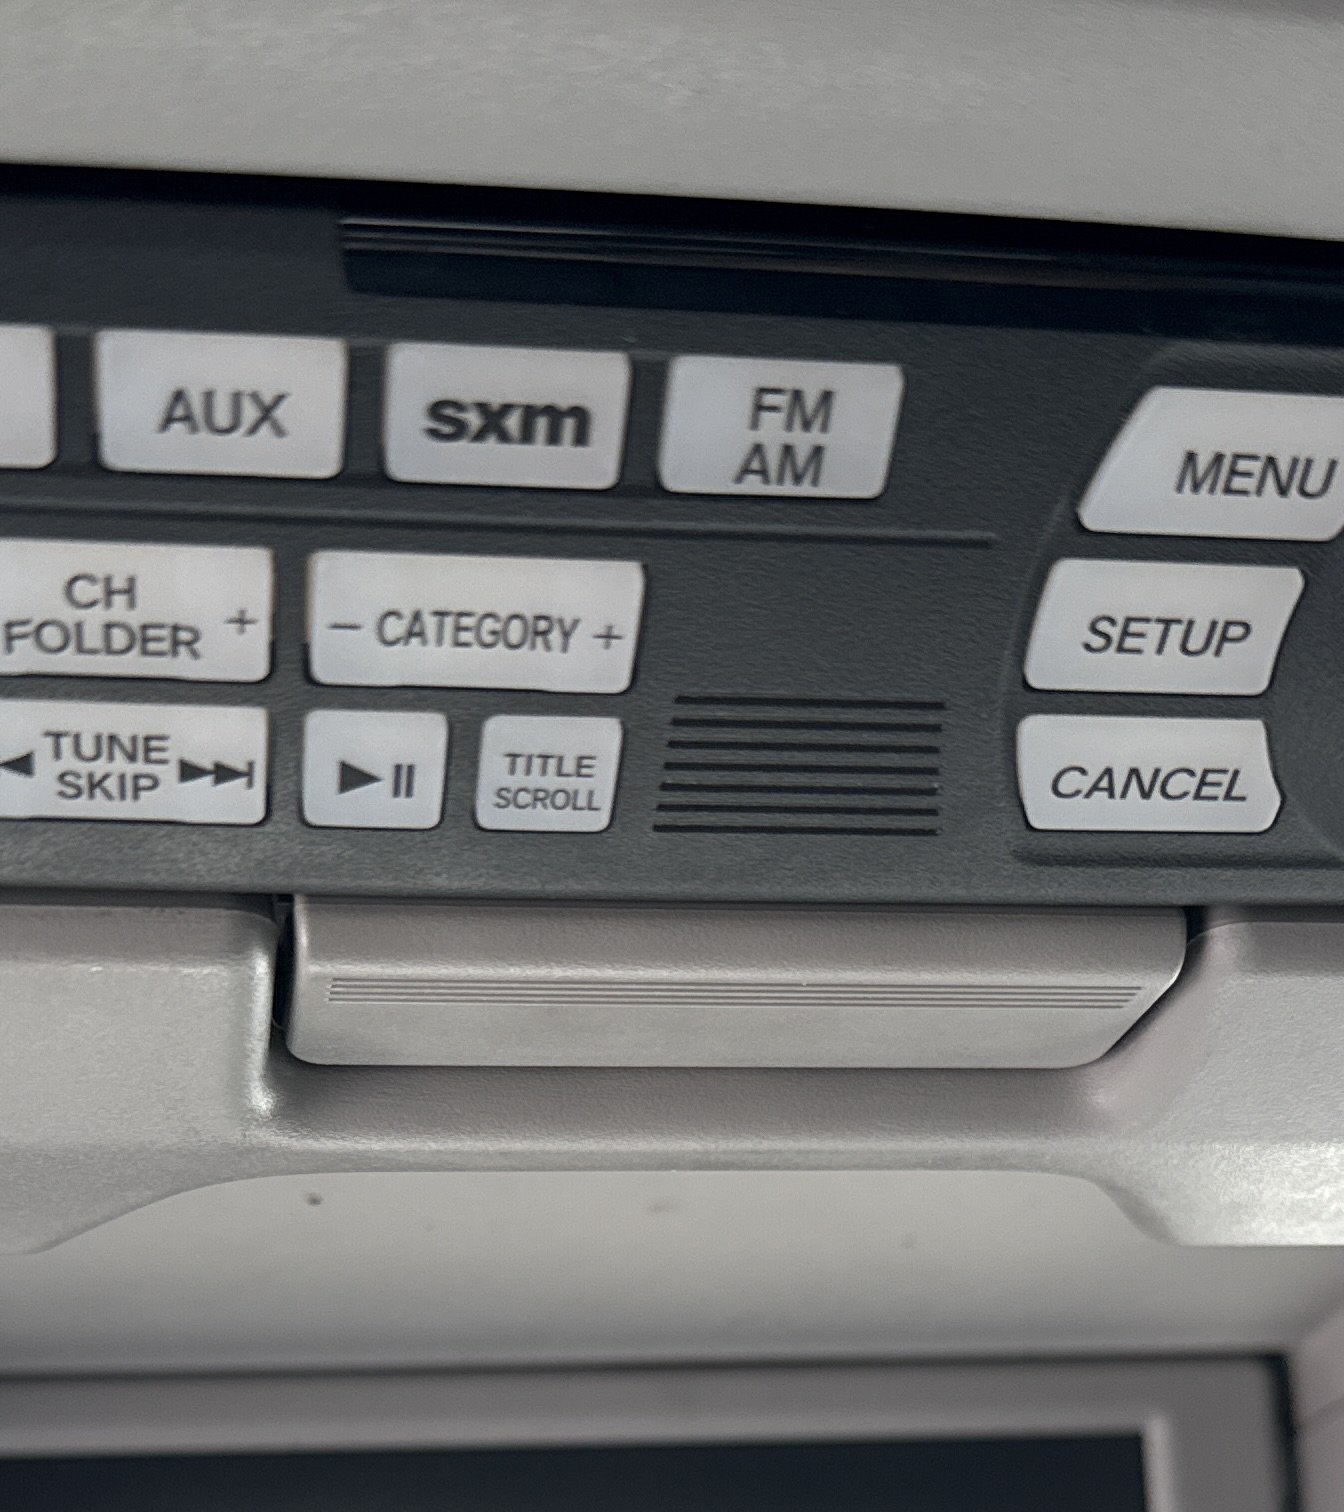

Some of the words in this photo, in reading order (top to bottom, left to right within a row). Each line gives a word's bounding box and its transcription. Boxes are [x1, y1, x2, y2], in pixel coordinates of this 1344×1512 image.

[158, 388, 287, 438] AUX
[423, 398, 592, 448] sxm
[750, 386, 835, 434] FM
[733, 442, 826, 488] AM
[1175, 450, 1338, 500] MENU
[63, 573, 137, 610] CH
[3, 618, 201, 661] FOLDER
[376, 609, 581, 654] CATEGORY
[1082, 614, 1252, 658] SETUP
[43, 730, 170, 765] TUNE
[503, 752, 597, 779] TITLE
[56, 769, 160, 802] SKIP
[493, 786, 602, 812] SCROLL
[1050, 765, 1247, 802] CANCEL
